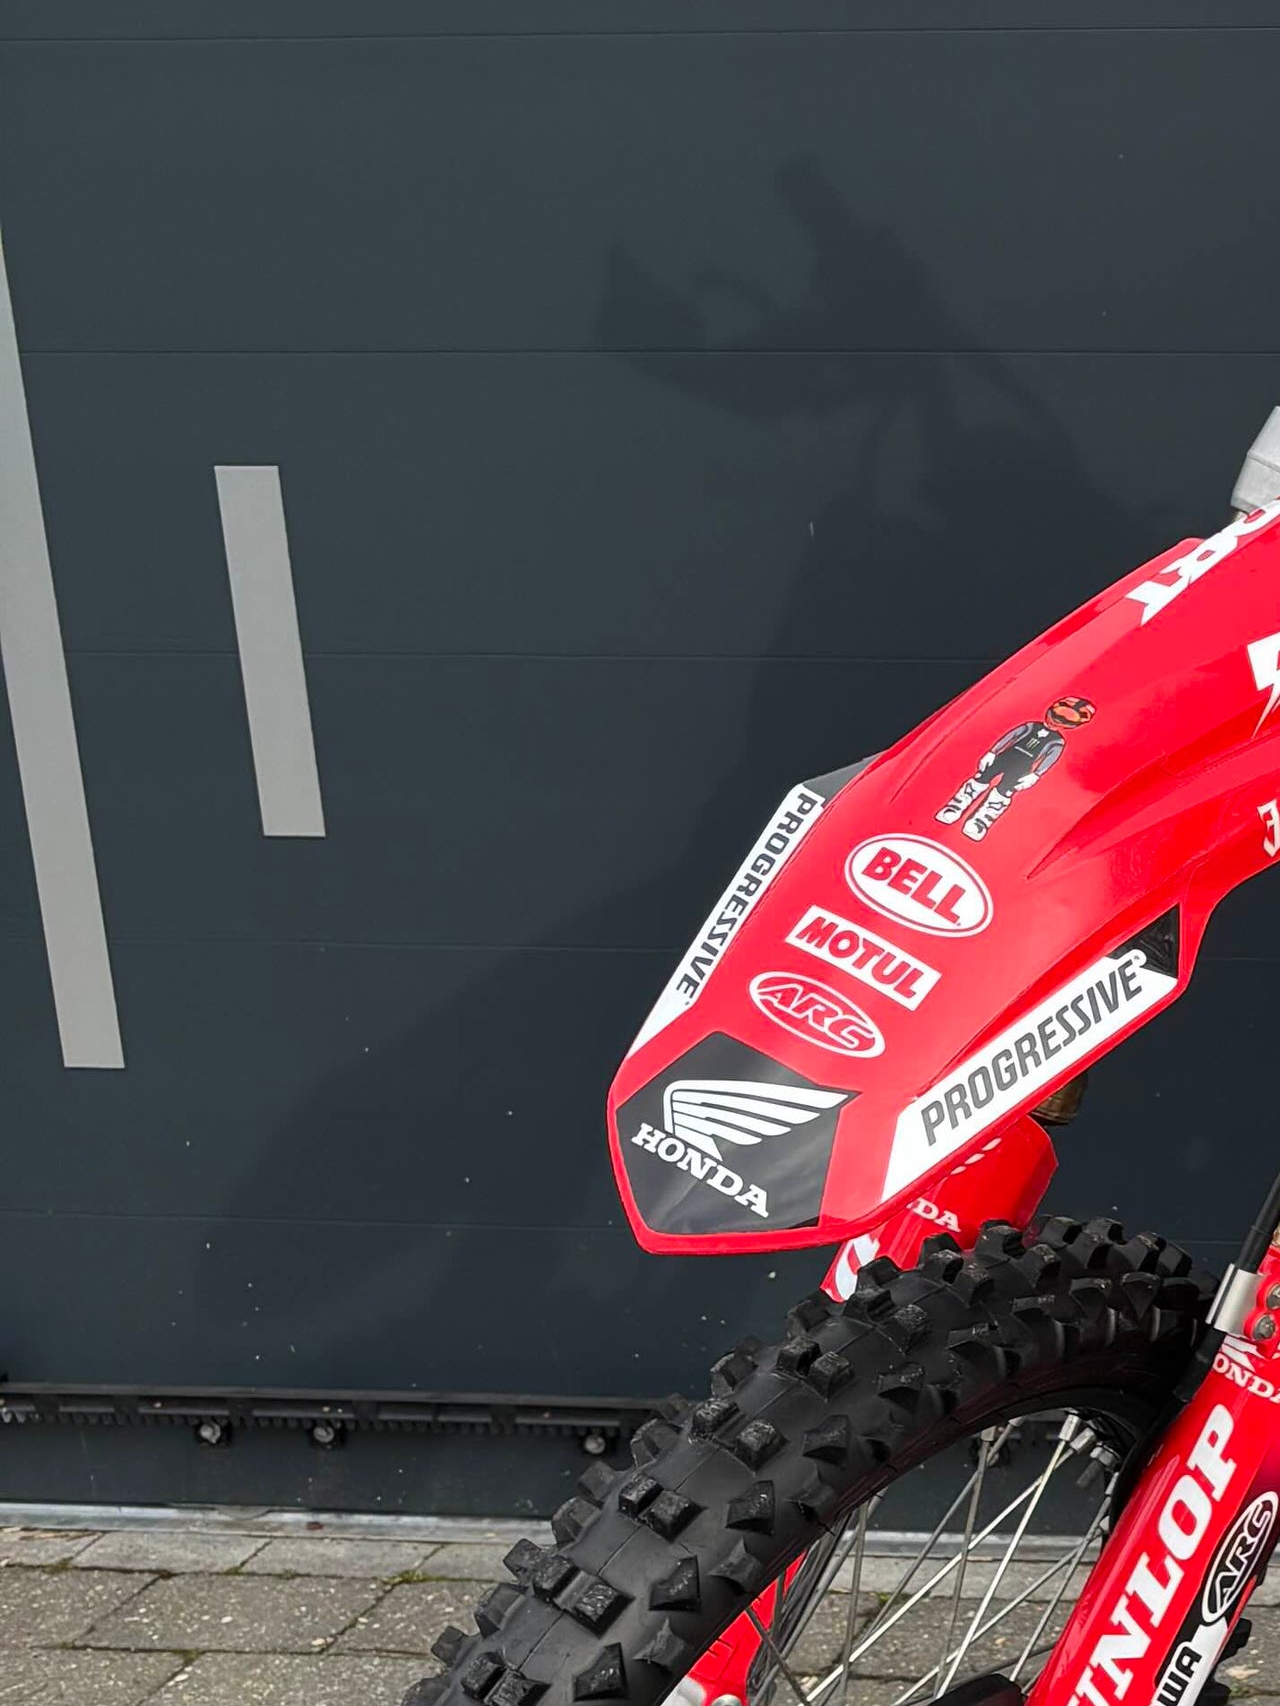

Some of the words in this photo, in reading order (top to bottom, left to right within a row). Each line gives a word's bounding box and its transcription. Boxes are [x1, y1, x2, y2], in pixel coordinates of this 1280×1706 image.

[676, 790, 820, 1001] PROGRESSIVE
[863, 846, 961, 927] BELL
[796, 916, 926, 1001] MOTUL
[756, 979, 881, 1050] ARC
[920, 962, 1145, 1147] PROGRESSIVE
[631, 1122, 770, 1219] HONDA
[1209, 1492, 1277, 1607] ARC
